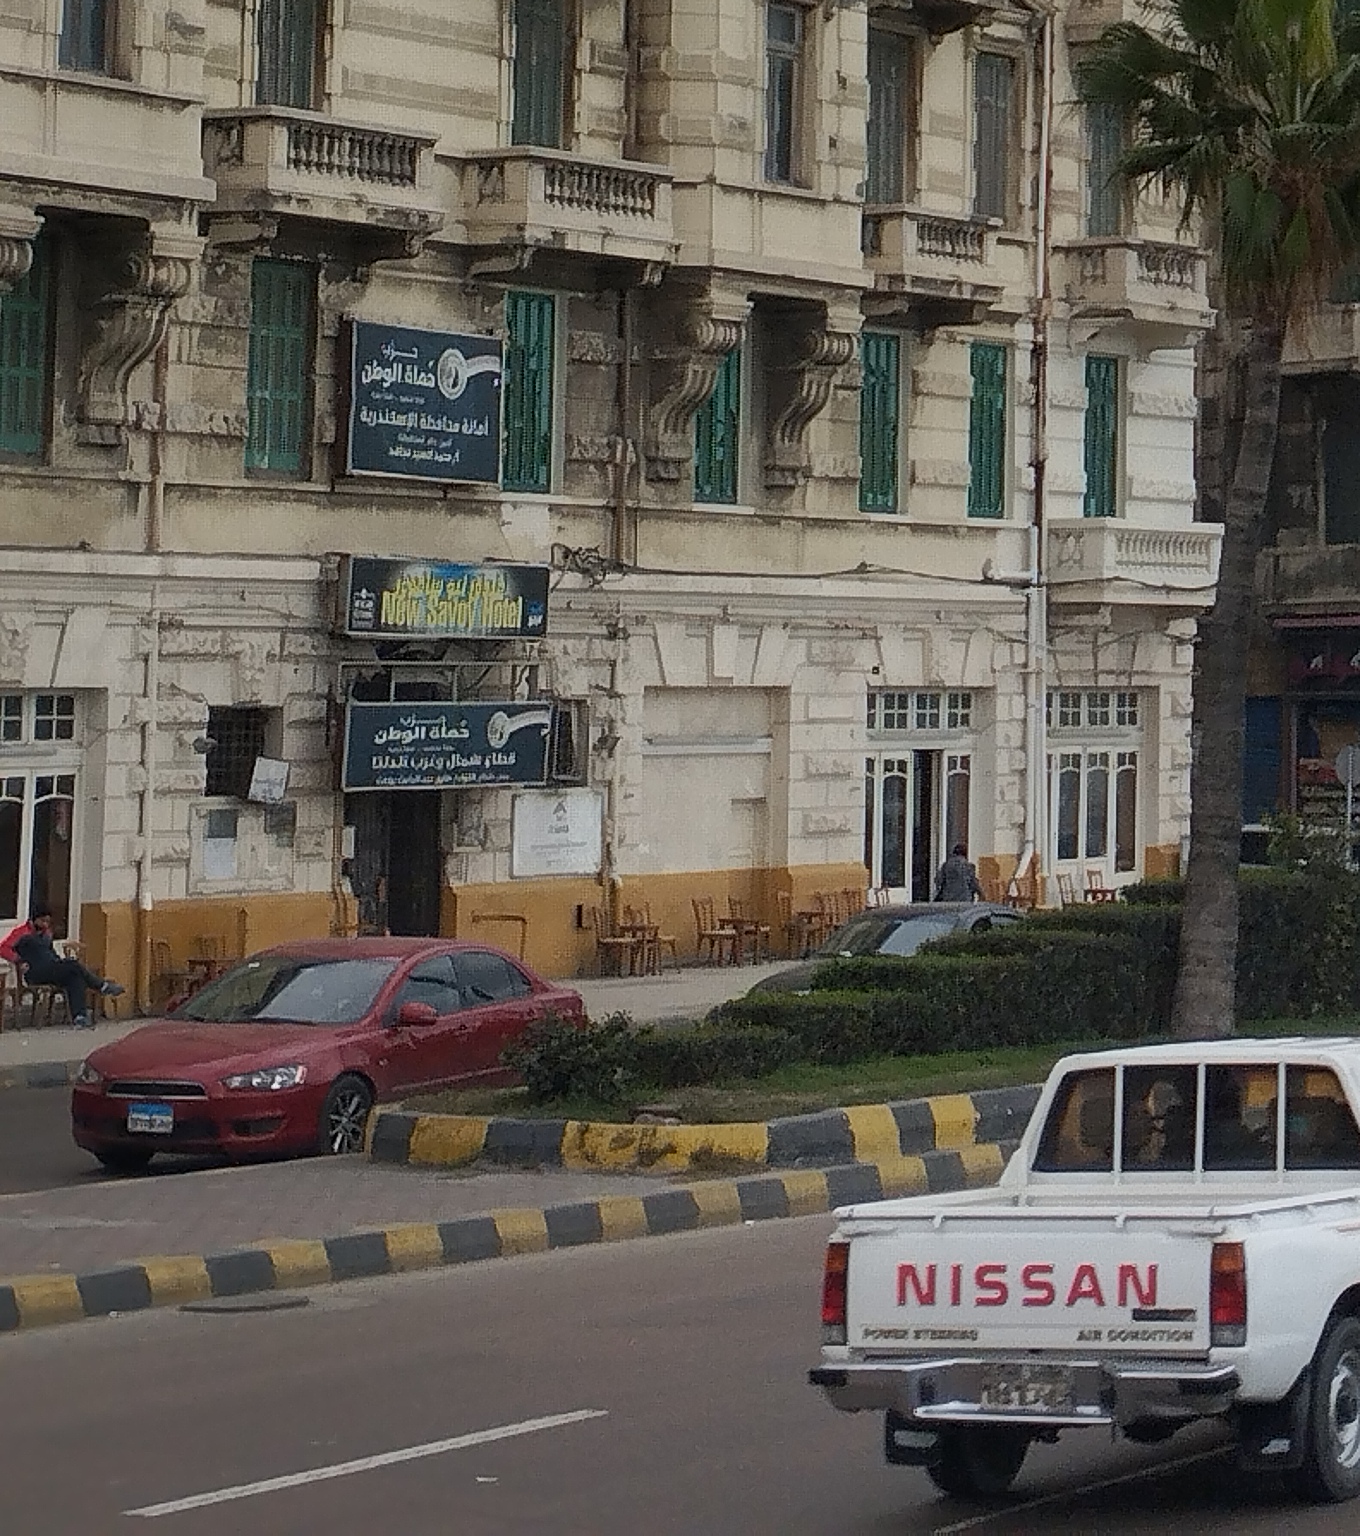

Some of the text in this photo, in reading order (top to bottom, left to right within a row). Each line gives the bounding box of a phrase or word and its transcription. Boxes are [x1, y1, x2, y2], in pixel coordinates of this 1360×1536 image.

[361, 360, 403, 388] الوطن
[381, 591, 421, 627] New
[426, 595, 475, 631] Savoy
[482, 595, 523, 629] Hotel
[374, 726, 426, 745] الوطن
[446, 753, 482, 770] شمال
[484, 751, 516, 769] قطاع
[896, 1263, 1159, 1308] NISSAN
[1076, 1329, 1194, 1343] AIR CONDITION
